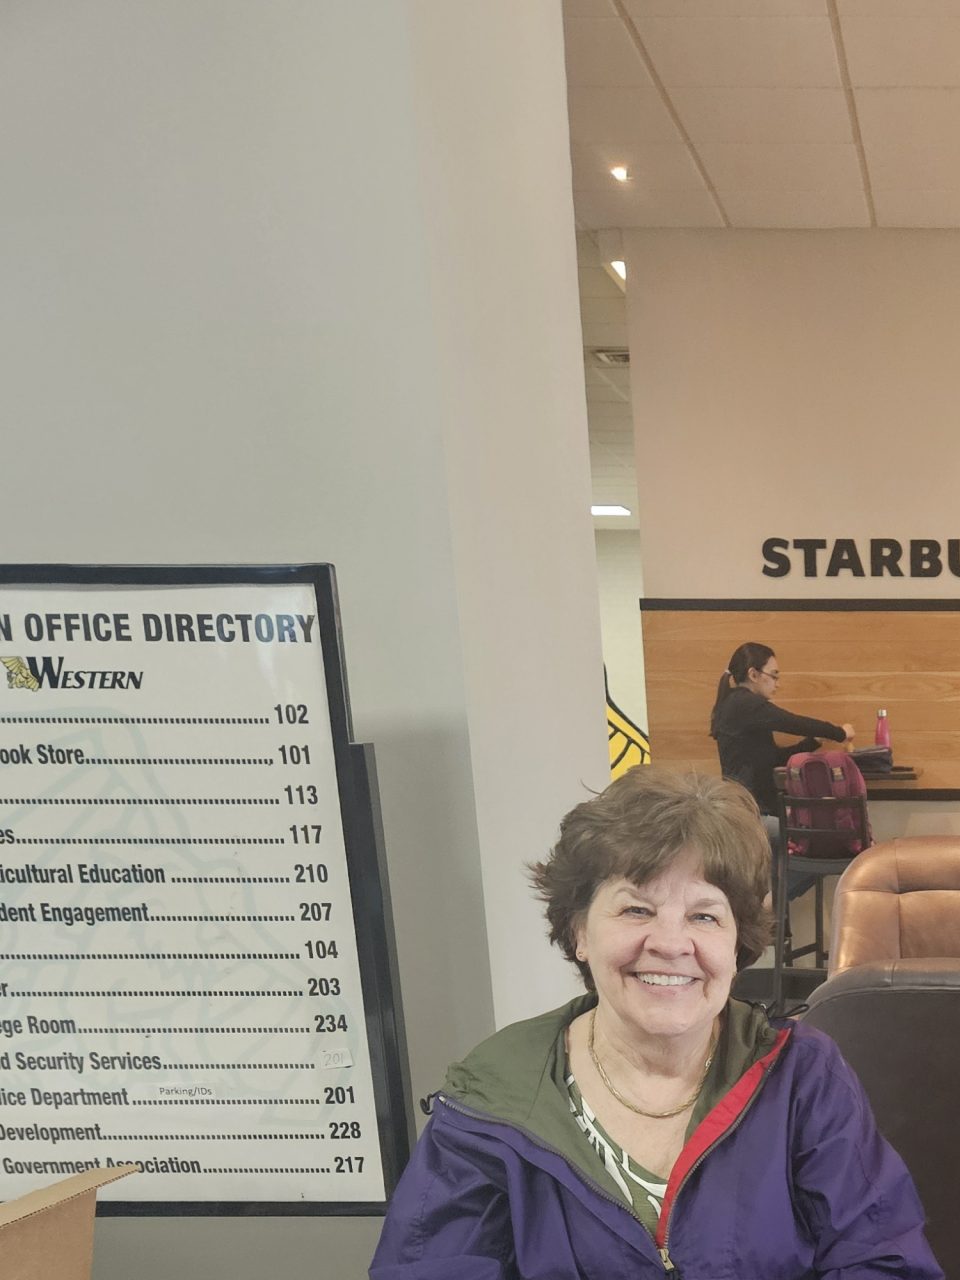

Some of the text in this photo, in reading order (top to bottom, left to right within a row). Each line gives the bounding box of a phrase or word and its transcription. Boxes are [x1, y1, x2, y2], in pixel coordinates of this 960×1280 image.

[24, 613, 132, 643] OFFICE
[142, 613, 316, 643] DIRECTORY
[26, 656, 144, 690] WESTERN
[274, 704, 310, 725] 102
[278, 745, 312, 765] 101
[284, 786, 319, 805] 113
[289, 825, 323, 845] 117
[80, 864, 166, 884] Education
[294, 864, 329, 883] 210
[40, 903, 150, 926] Engagement
[299, 903, 332, 921] 207
[304, 940, 339, 959] 104
[307, 978, 341, 997] 203
[27, 1015, 77, 1034] Room
[314, 1014, 348, 1033] 234
[15, 1052, 85, 1074] Security
[90, 1052, 162, 1071] Services
[30, 1088, 130, 1111] Department
[324, 1086, 356, 1104] 201
[159, 1086, 213, 1098] Parking/IDs
[329, 1122, 362, 1140] 228
[3, 1157, 101, 1174] Government
[334, 1156, 365, 1174] 217
